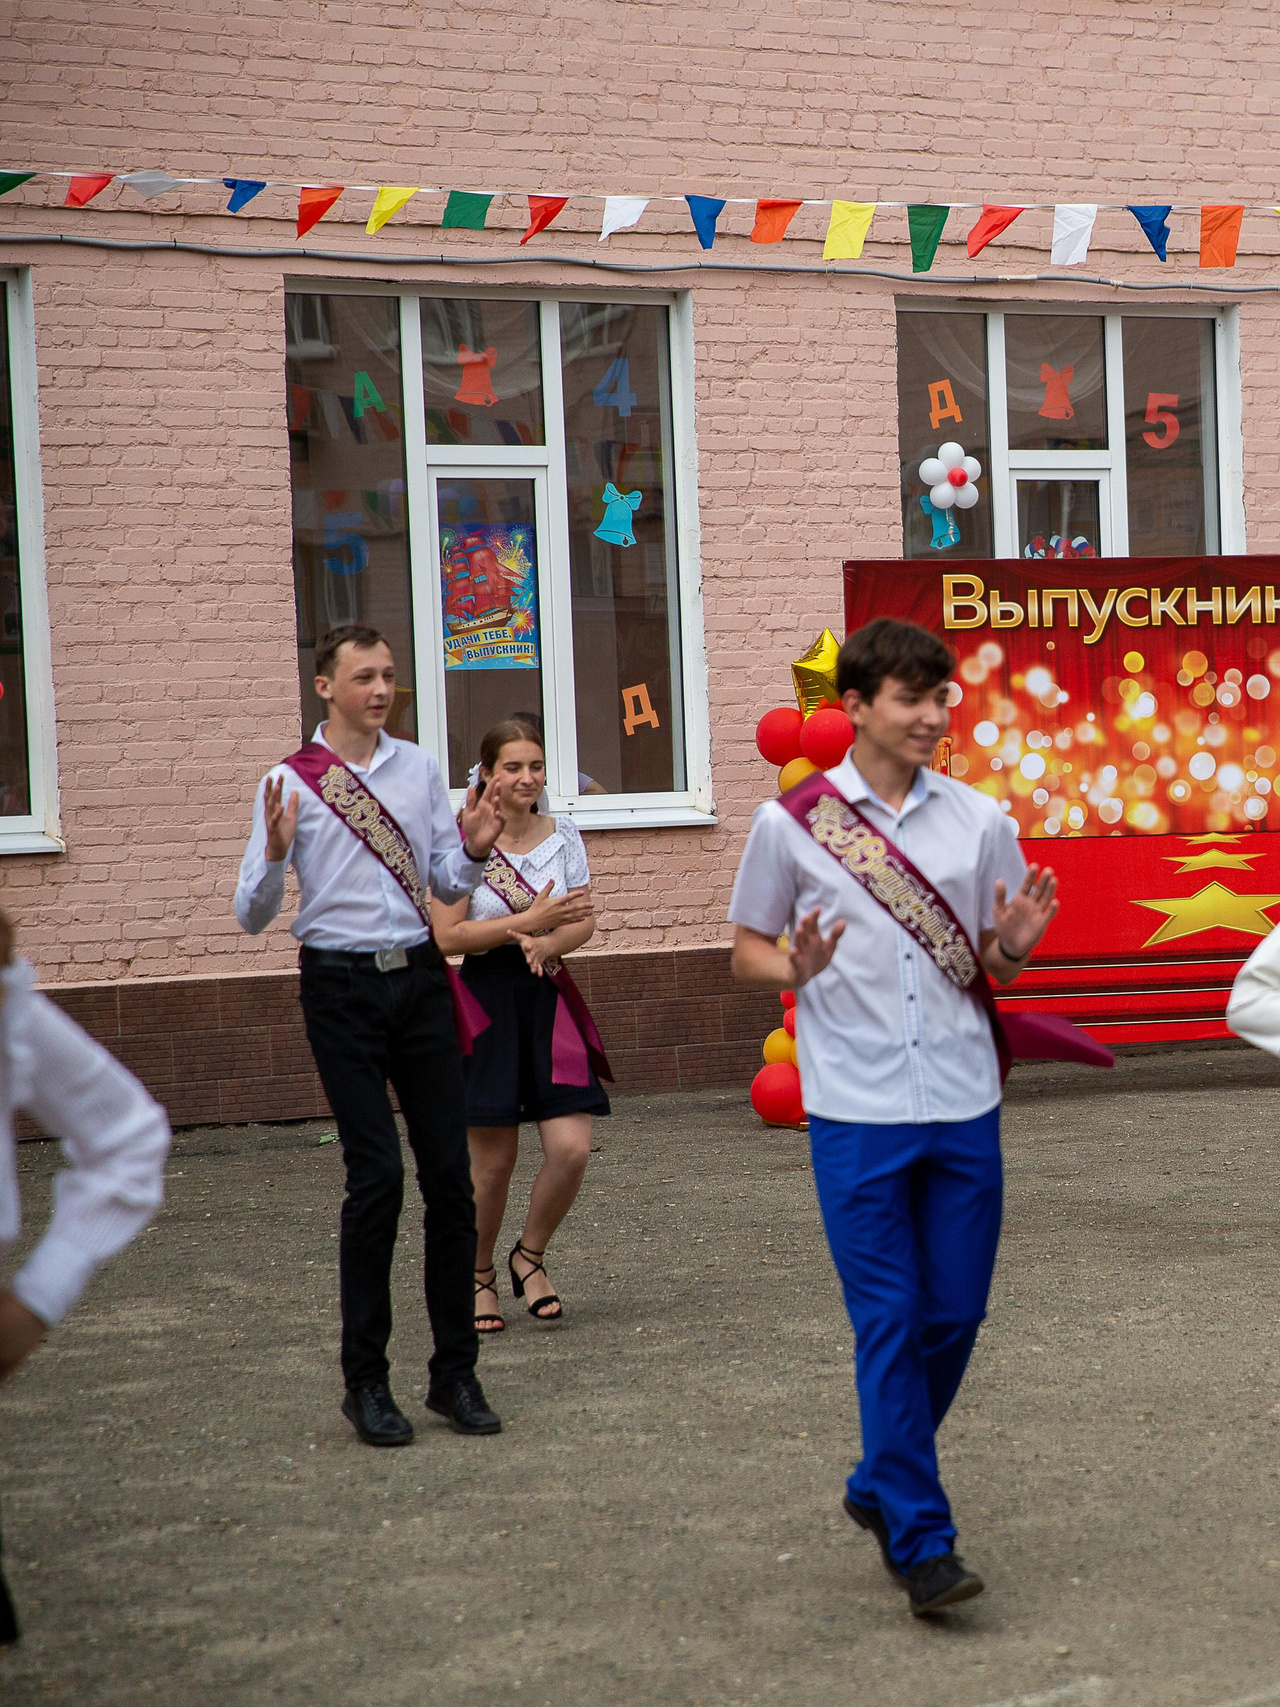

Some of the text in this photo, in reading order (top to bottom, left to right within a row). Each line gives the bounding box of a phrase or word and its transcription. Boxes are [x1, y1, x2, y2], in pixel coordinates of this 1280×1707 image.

[592, 357, 637, 417] 4
[927, 378, 963, 429] Д
[1142, 392, 1180, 449] 5
[322, 511, 369, 576] 5
[445, 629, 512, 650] УДАЧИ ТЕБЕ,
[466, 644, 534, 659] ВЫПУСКНИК!
[621, 683, 659, 736] Д
